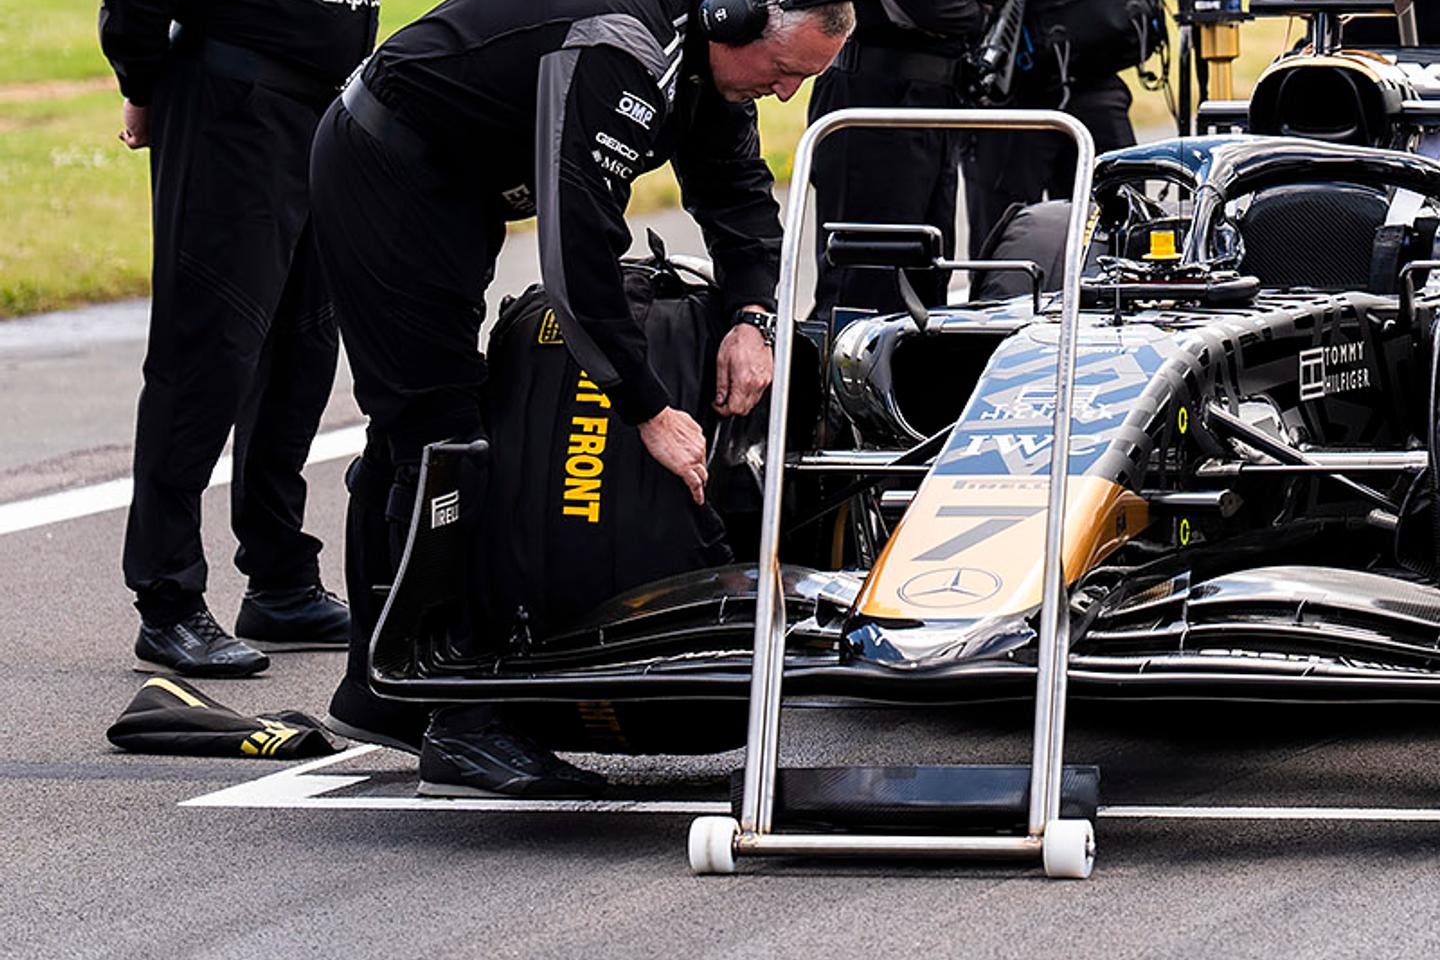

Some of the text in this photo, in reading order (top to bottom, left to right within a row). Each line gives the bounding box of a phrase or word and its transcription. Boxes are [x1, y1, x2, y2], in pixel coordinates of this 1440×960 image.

[617, 95, 655, 127] OMP
[595, 131, 640, 161] GEICO
[600, 156, 633, 179] MSC
[1324, 341, 1365, 366] TOMMY
[562, 416, 609, 523] FRONT
[909, 505, 1049, 562] 7
